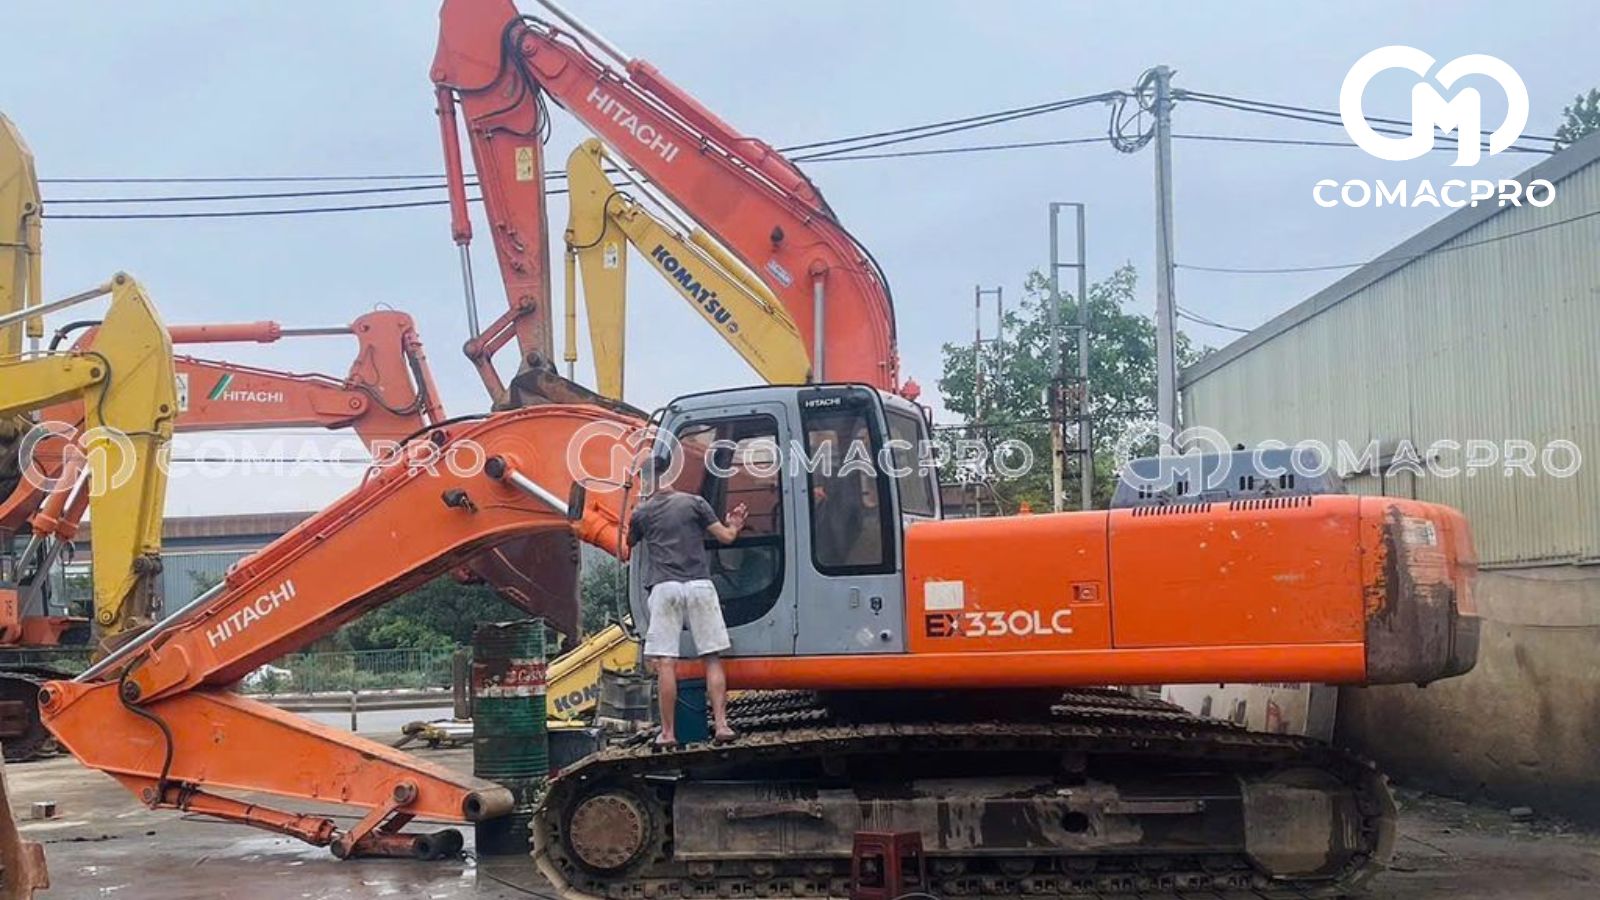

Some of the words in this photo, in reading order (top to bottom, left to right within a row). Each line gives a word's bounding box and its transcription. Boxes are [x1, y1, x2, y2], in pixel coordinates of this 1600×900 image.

[586, 86, 680, 163] HITACHI
[651, 244, 731, 324] KOMATSU
[223, 391, 284, 403] HITACHI
[805, 397, 841, 407] HITACHI
[206, 579, 296, 649] HITACHI
[925, 609, 1074, 638] EX330LC
